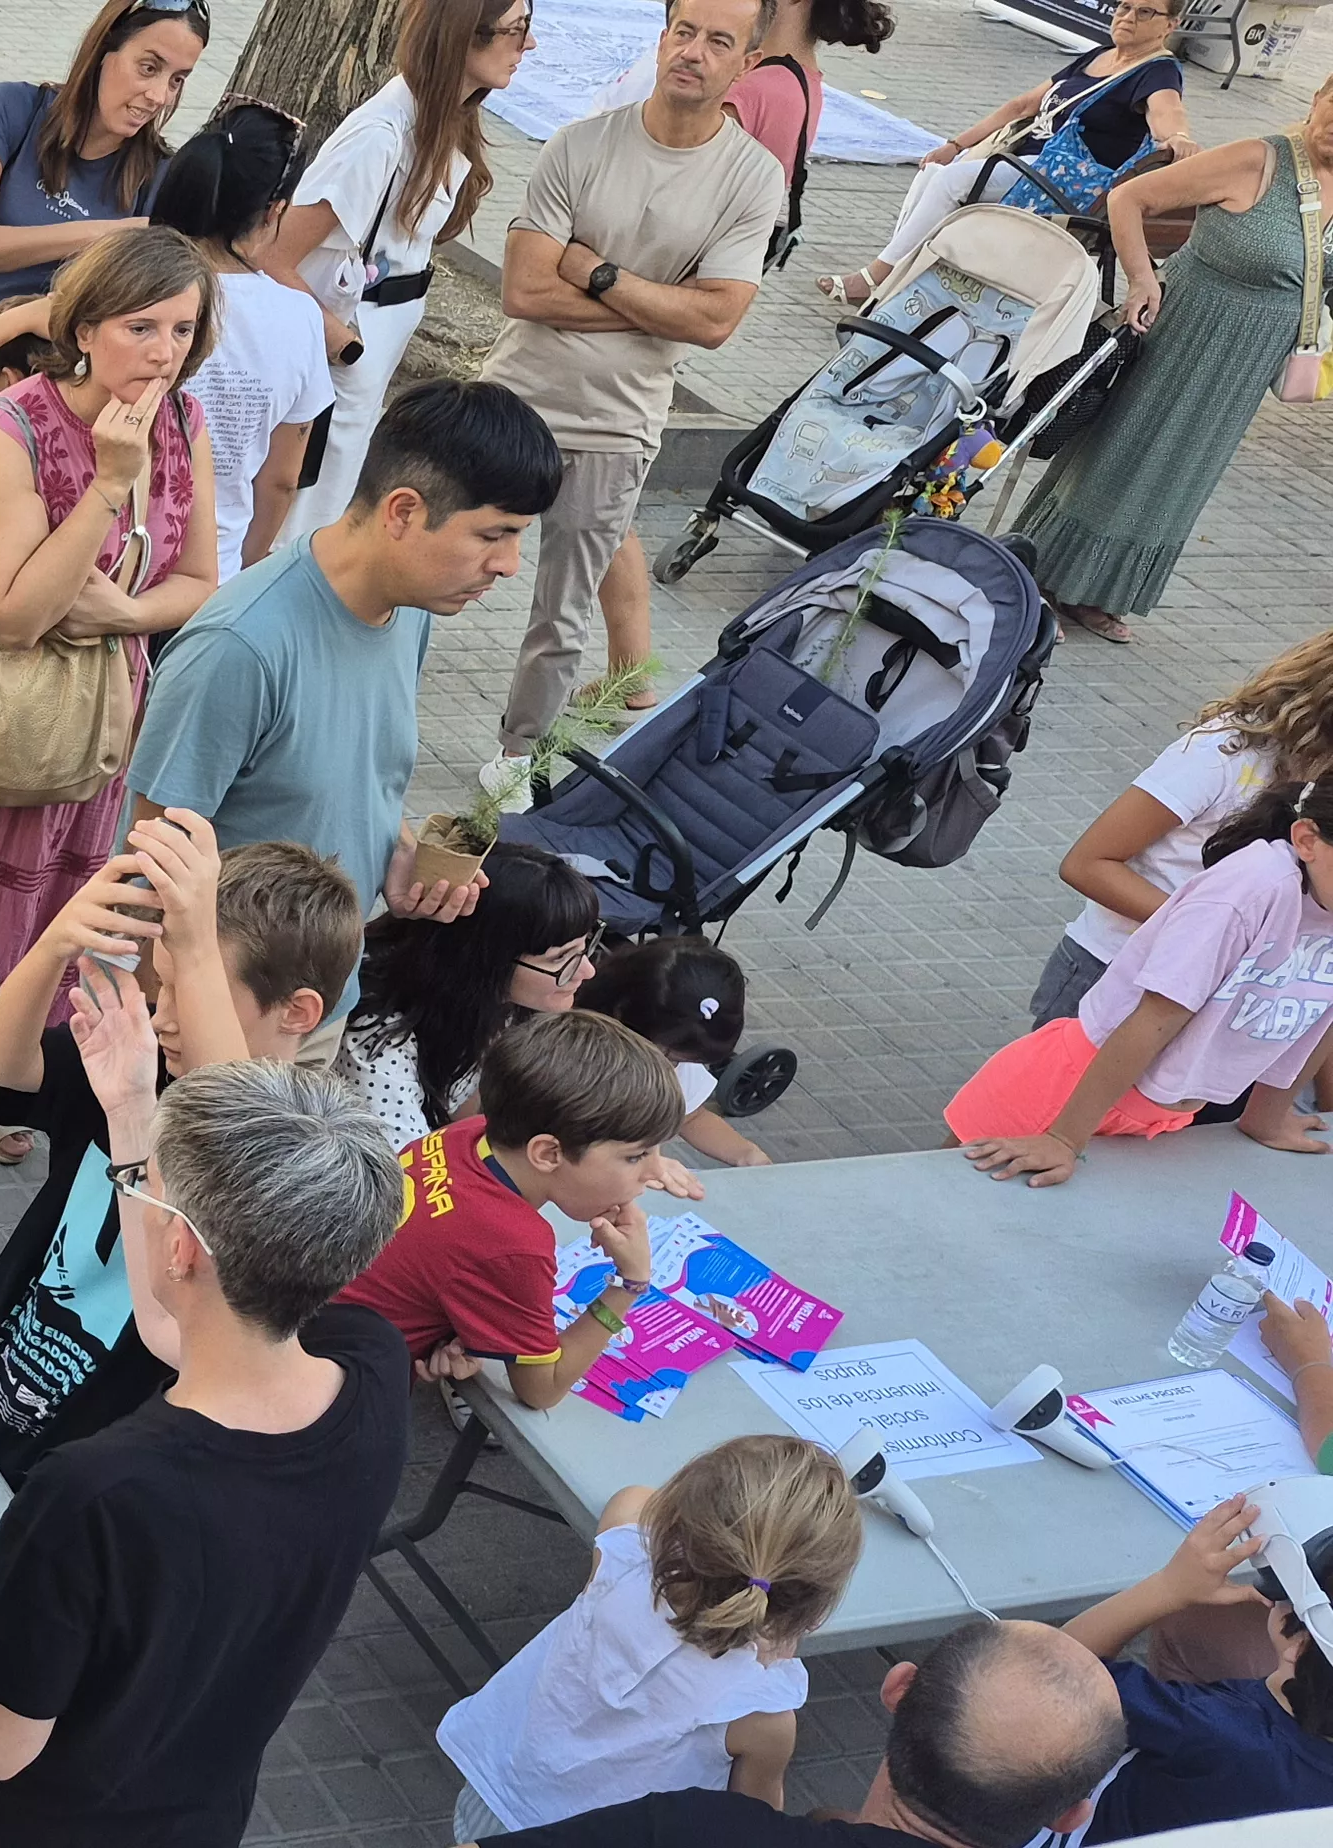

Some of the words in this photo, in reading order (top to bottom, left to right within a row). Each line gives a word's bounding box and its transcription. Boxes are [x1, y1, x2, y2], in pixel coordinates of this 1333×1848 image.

[814, 1359, 877, 1384] grupos
[797, 1395, 832, 1412] los
[828, 1393, 854, 1410] de
[854, 1380, 945, 1406] influencia
[1109, 1392, 1155, 1406] WELLME
[1154, 1385, 1196, 1399] PROJECT
[874, 1408, 929, 1429] social
